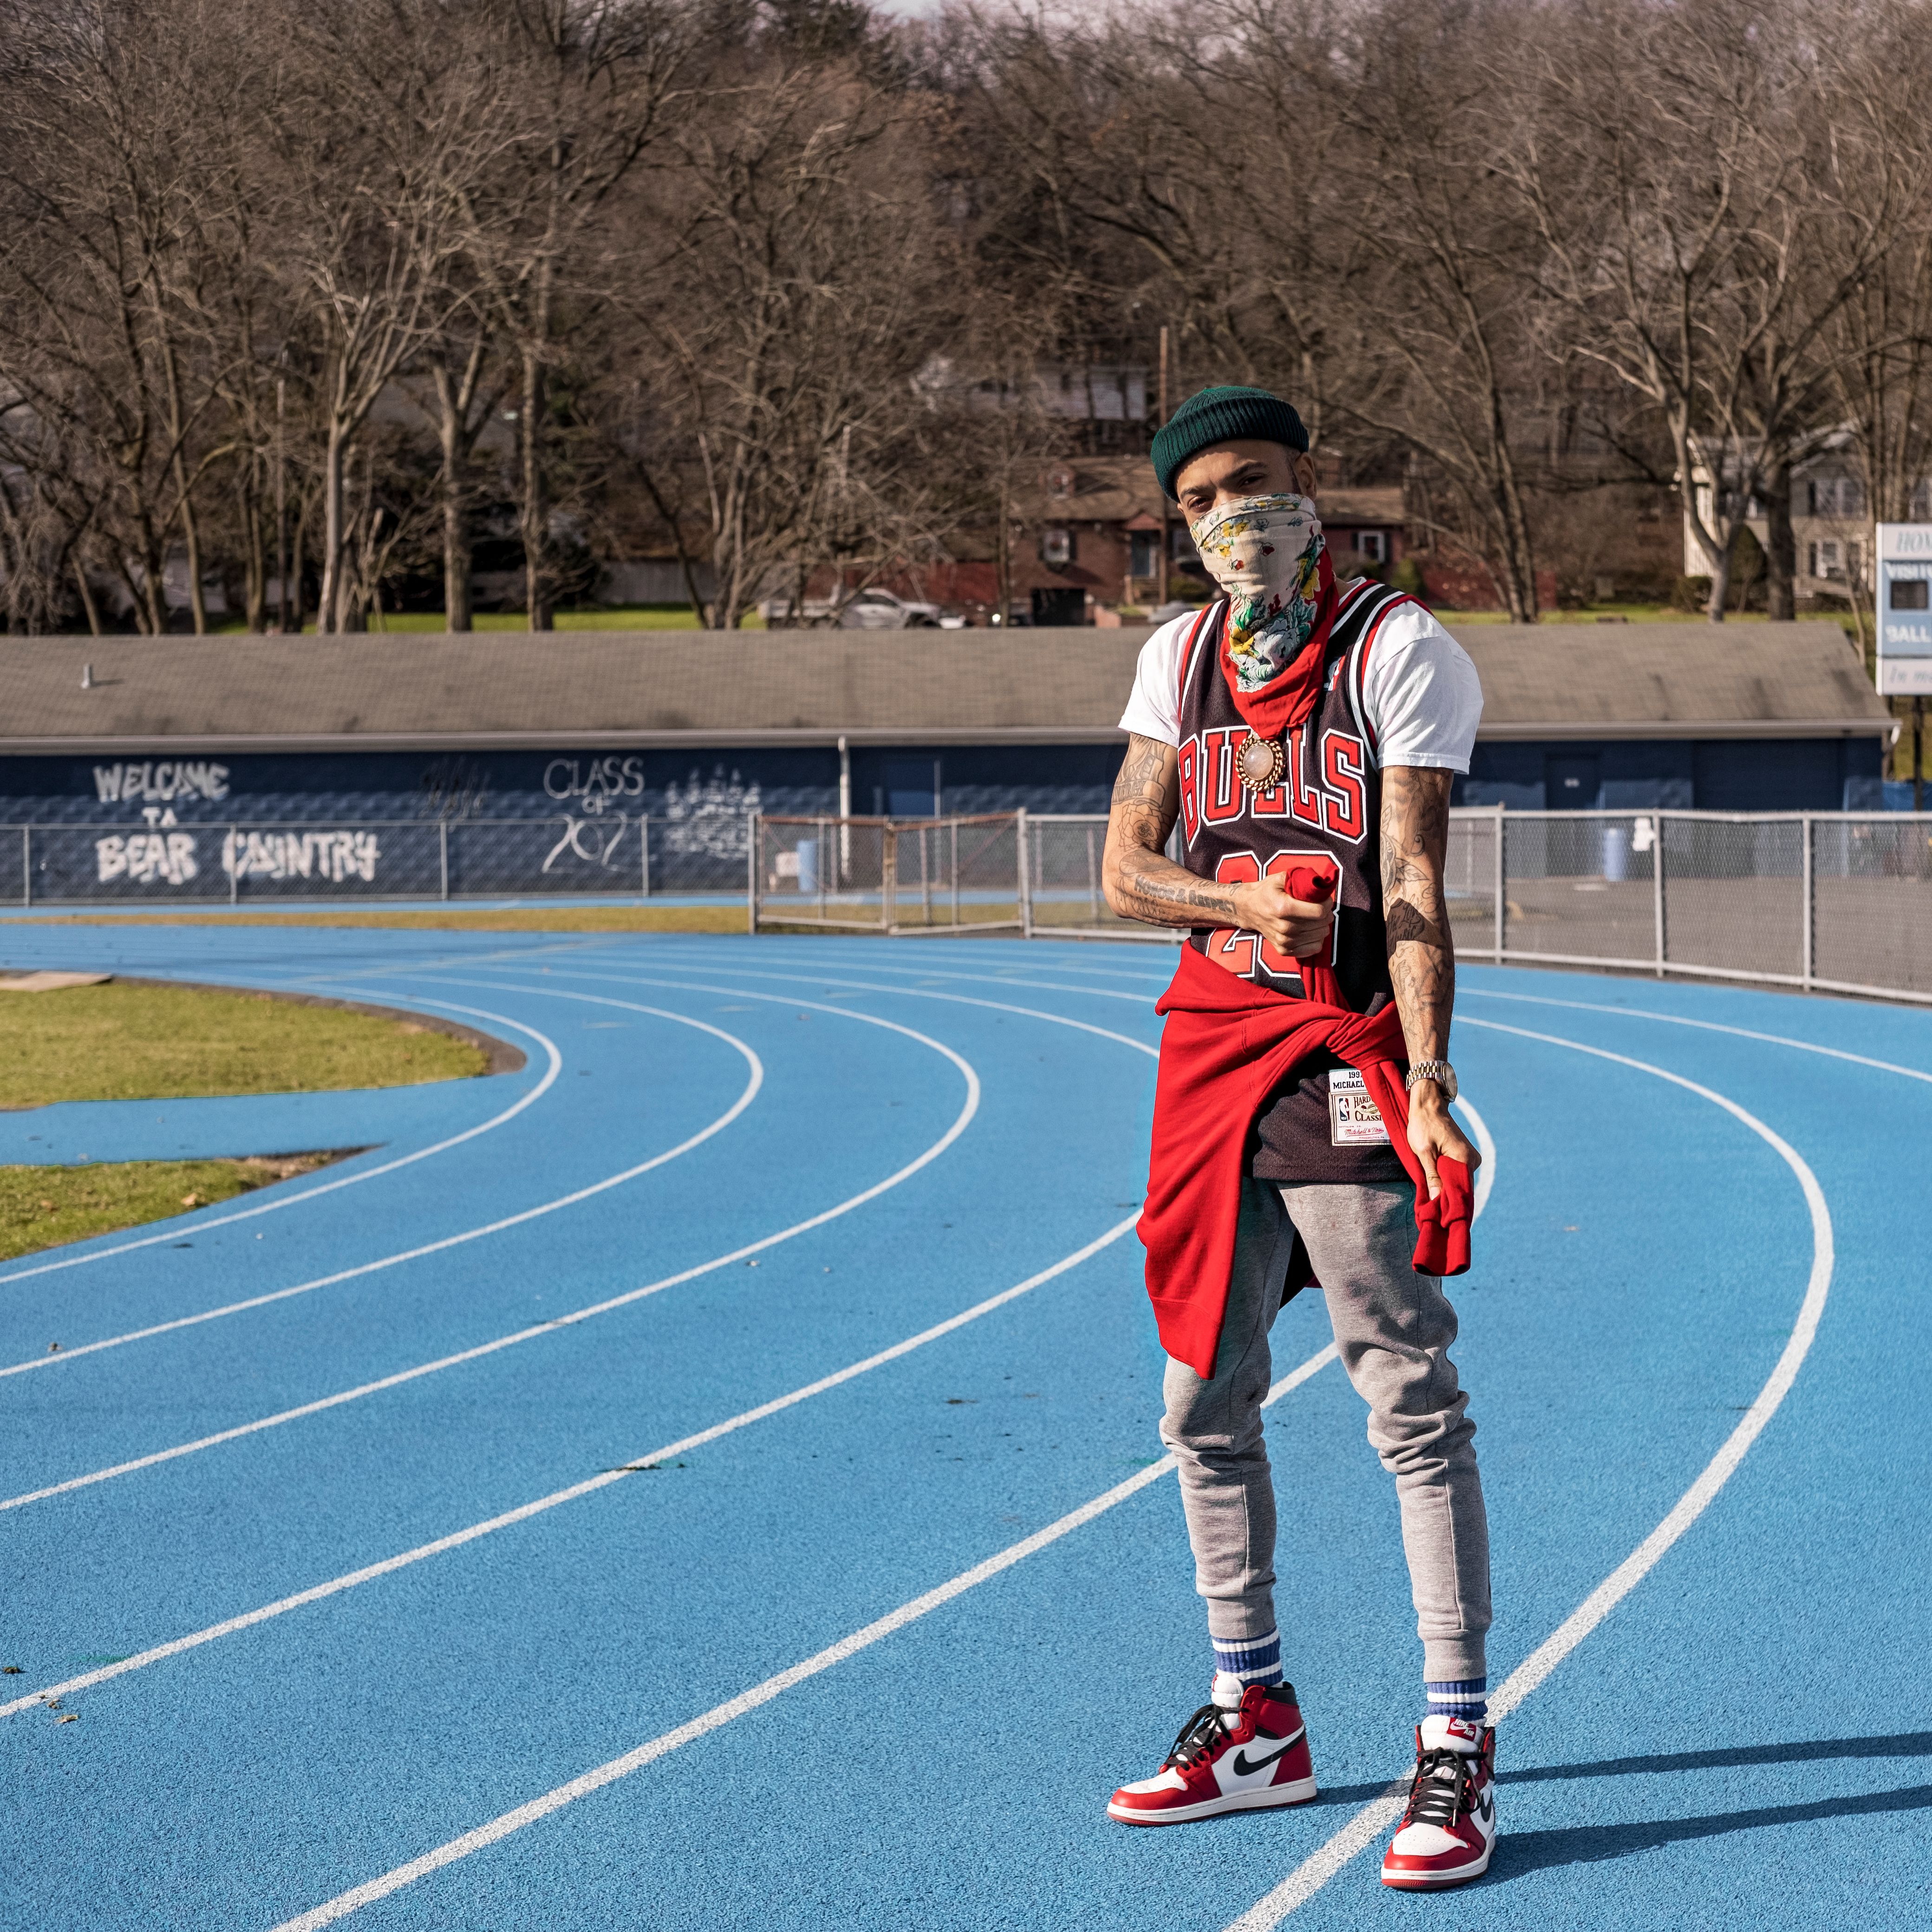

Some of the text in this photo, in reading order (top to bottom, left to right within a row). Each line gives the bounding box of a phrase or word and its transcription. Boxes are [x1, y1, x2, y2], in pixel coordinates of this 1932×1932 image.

[543, 756, 645, 799] CLASS
[95, 833, 197, 885] BEAR
[1333, 1080, 1364, 1089] MICHAEL
[1454, 1718, 1469, 1728] NIKE
[1463, 1729, 1475, 1737] AIR
